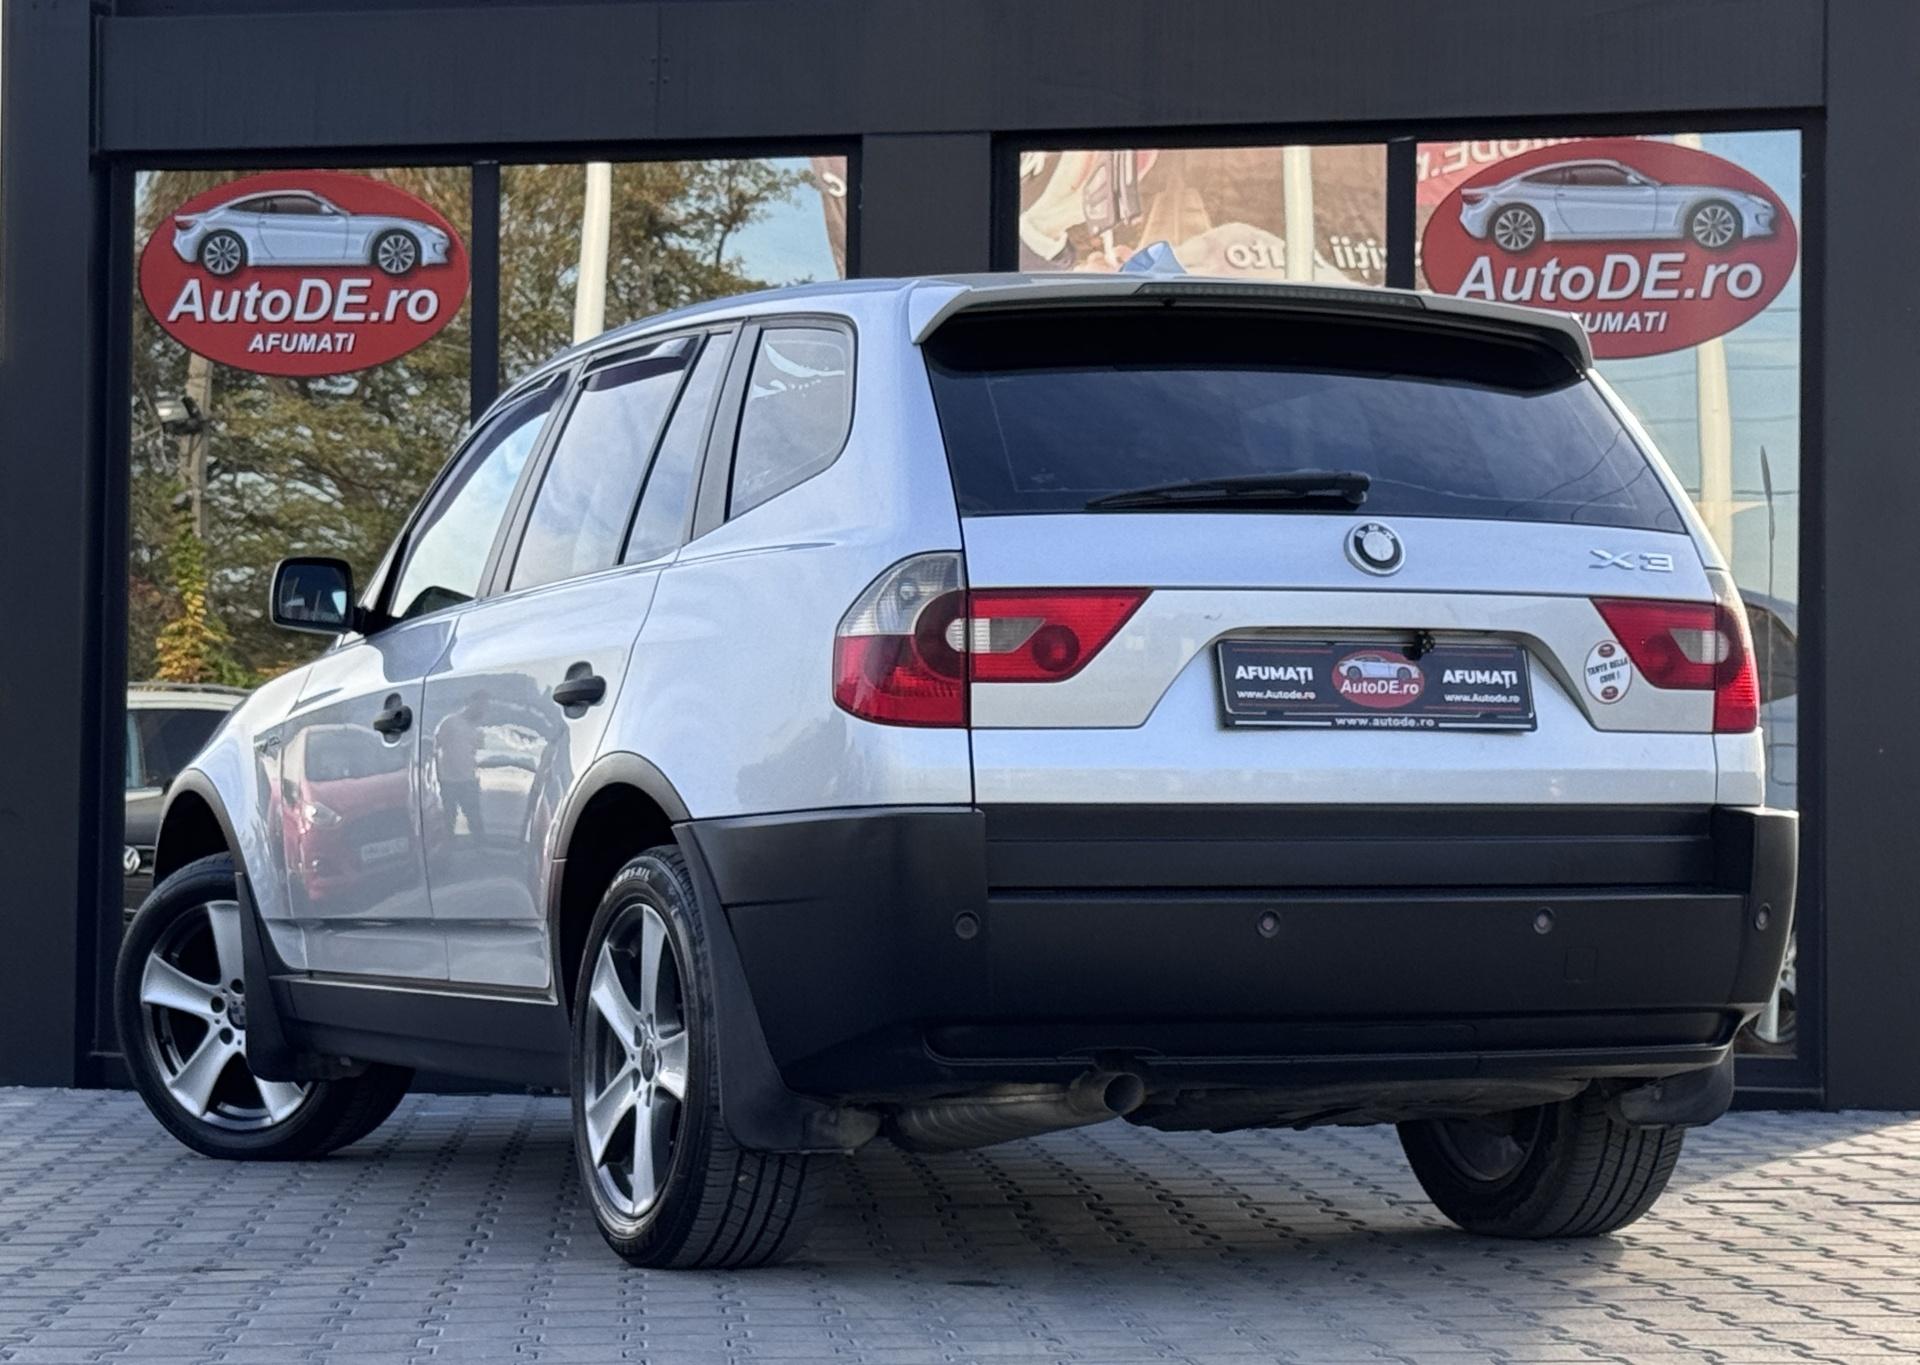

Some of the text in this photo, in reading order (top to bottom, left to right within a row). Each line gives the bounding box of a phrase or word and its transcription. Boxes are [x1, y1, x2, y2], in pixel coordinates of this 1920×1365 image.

[1456, 252, 1763, 301] AutoDE.ro
[167, 278, 440, 323] AutoDE.ro
[1578, 311, 1668, 333] UMATI
[248, 333, 357, 353] AFUMATI
[1588, 550, 1675, 573] X3
[1340, 679, 1420, 695] AutoDE.ro
[1335, 716, 1436, 728] www.autode.ro
